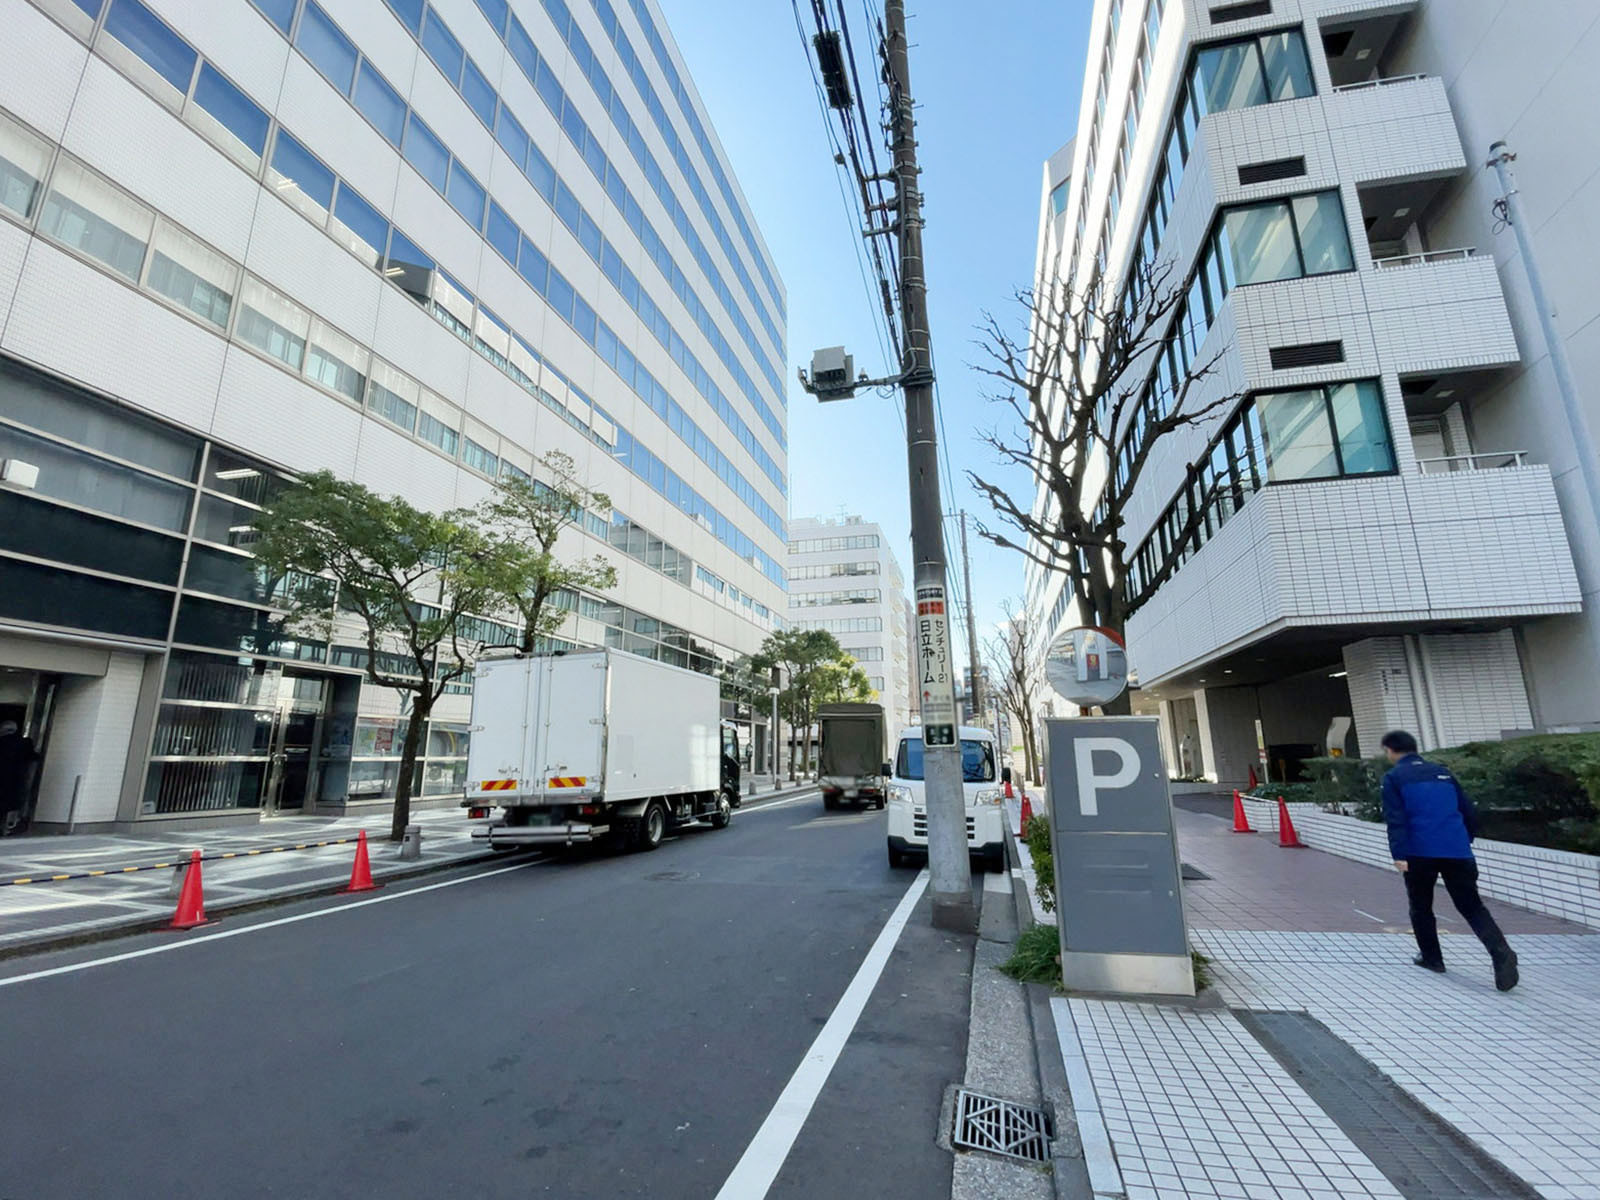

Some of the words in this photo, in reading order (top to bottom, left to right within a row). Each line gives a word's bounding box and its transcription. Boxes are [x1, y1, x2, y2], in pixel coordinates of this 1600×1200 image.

[920, 620, 935, 683] 日立ホーム
[1073, 737, 1141, 816] P
